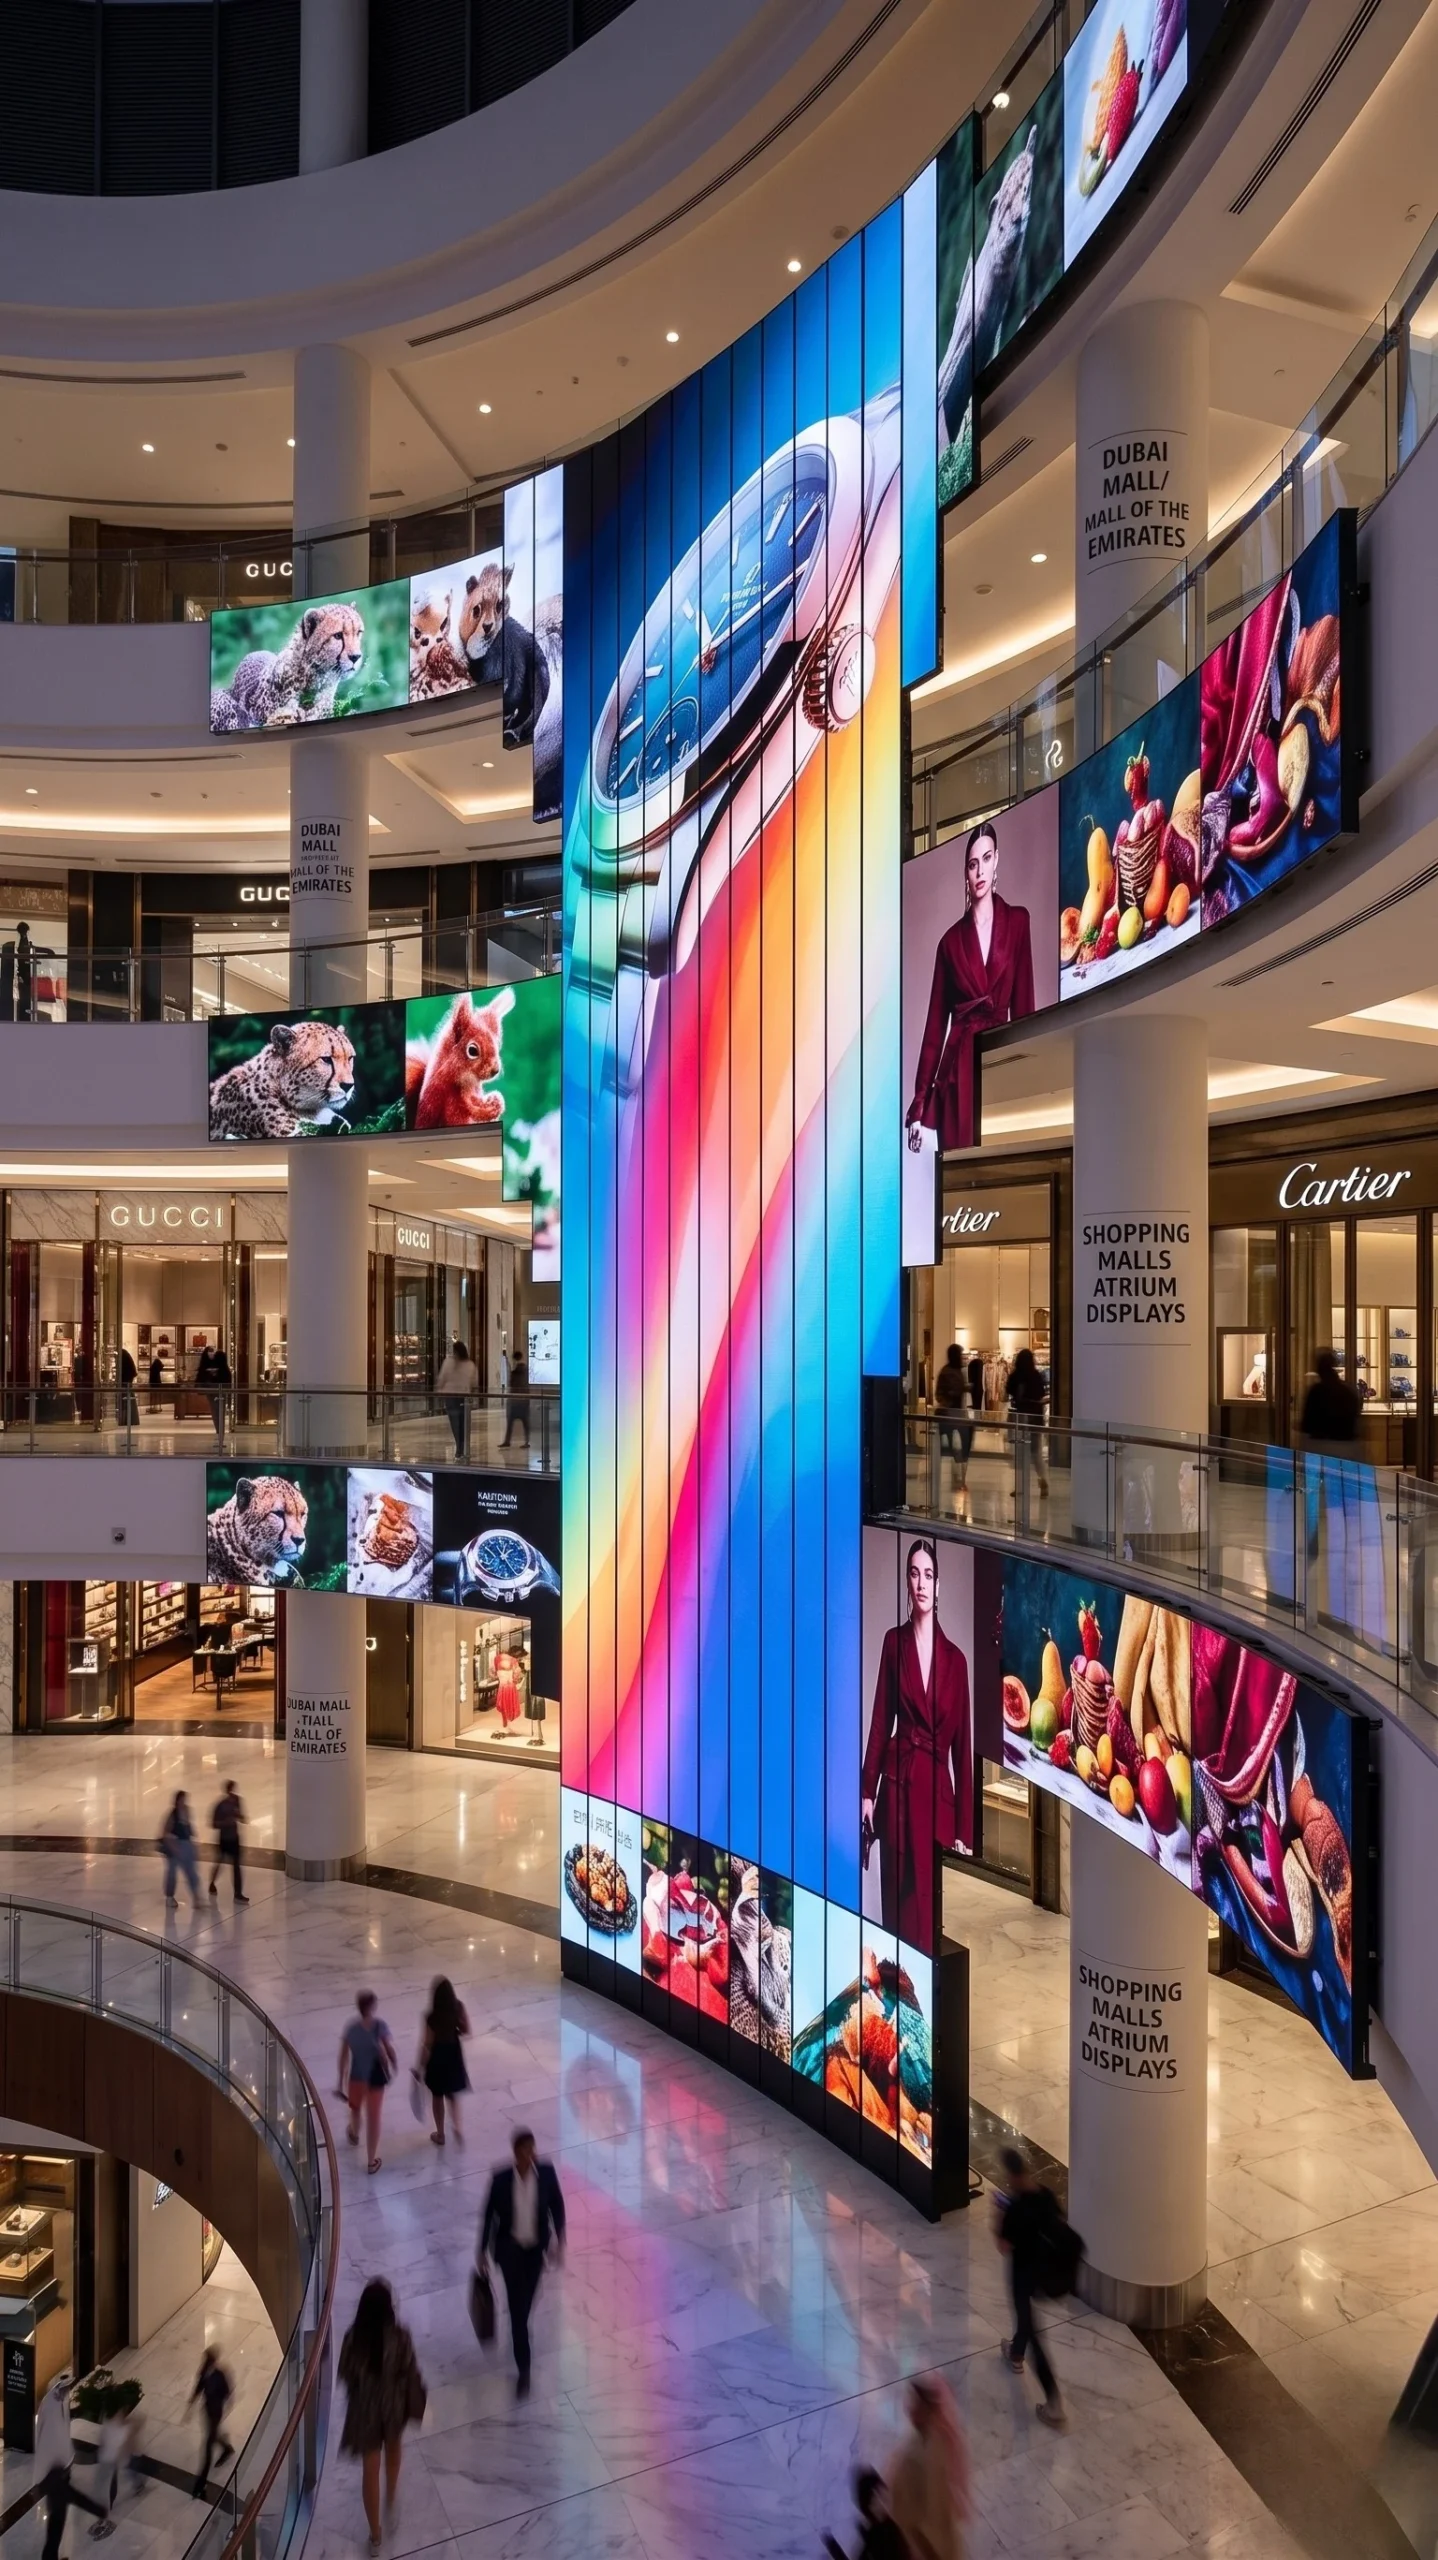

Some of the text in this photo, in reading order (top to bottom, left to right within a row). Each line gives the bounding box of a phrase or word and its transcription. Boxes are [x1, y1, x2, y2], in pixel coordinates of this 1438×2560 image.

[1103, 441, 1168, 470] DUBAI
[1103, 470, 1170, 499] MALL/
[1085, 500, 1190, 534] MALL OF THE
[1088, 525, 1186, 560] EMIRATES
[301, 823, 341, 837] DUBAI
[302, 840, 337, 852] MALL
[315, 864, 330, 875] OF
[334, 864, 355, 878] THE
[292, 878, 352, 895] EMIRATES
[1279, 1163, 1412, 1209] Cartier
[110, 1205, 224, 1228] GUCCI
[1083, 1223, 1190, 1246] SHOPPING
[1098, 1250, 1172, 1271] MALLS
[1093, 1277, 1177, 1297] ATRIUM
[1087, 1303, 1186, 1323] DISPLAYS
[319, 1699, 351, 1712] MALL
[326, 1728, 342, 1740] OF
[290, 1741, 347, 1755] EMIRATES
[1079, 1964, 1182, 2002] SHOPPING
[1093, 1996, 1163, 2028] MALLS
[1088, 2021, 1169, 2054] ATRIUM
[1081, 2040, 1178, 2080] DISPLAYS
